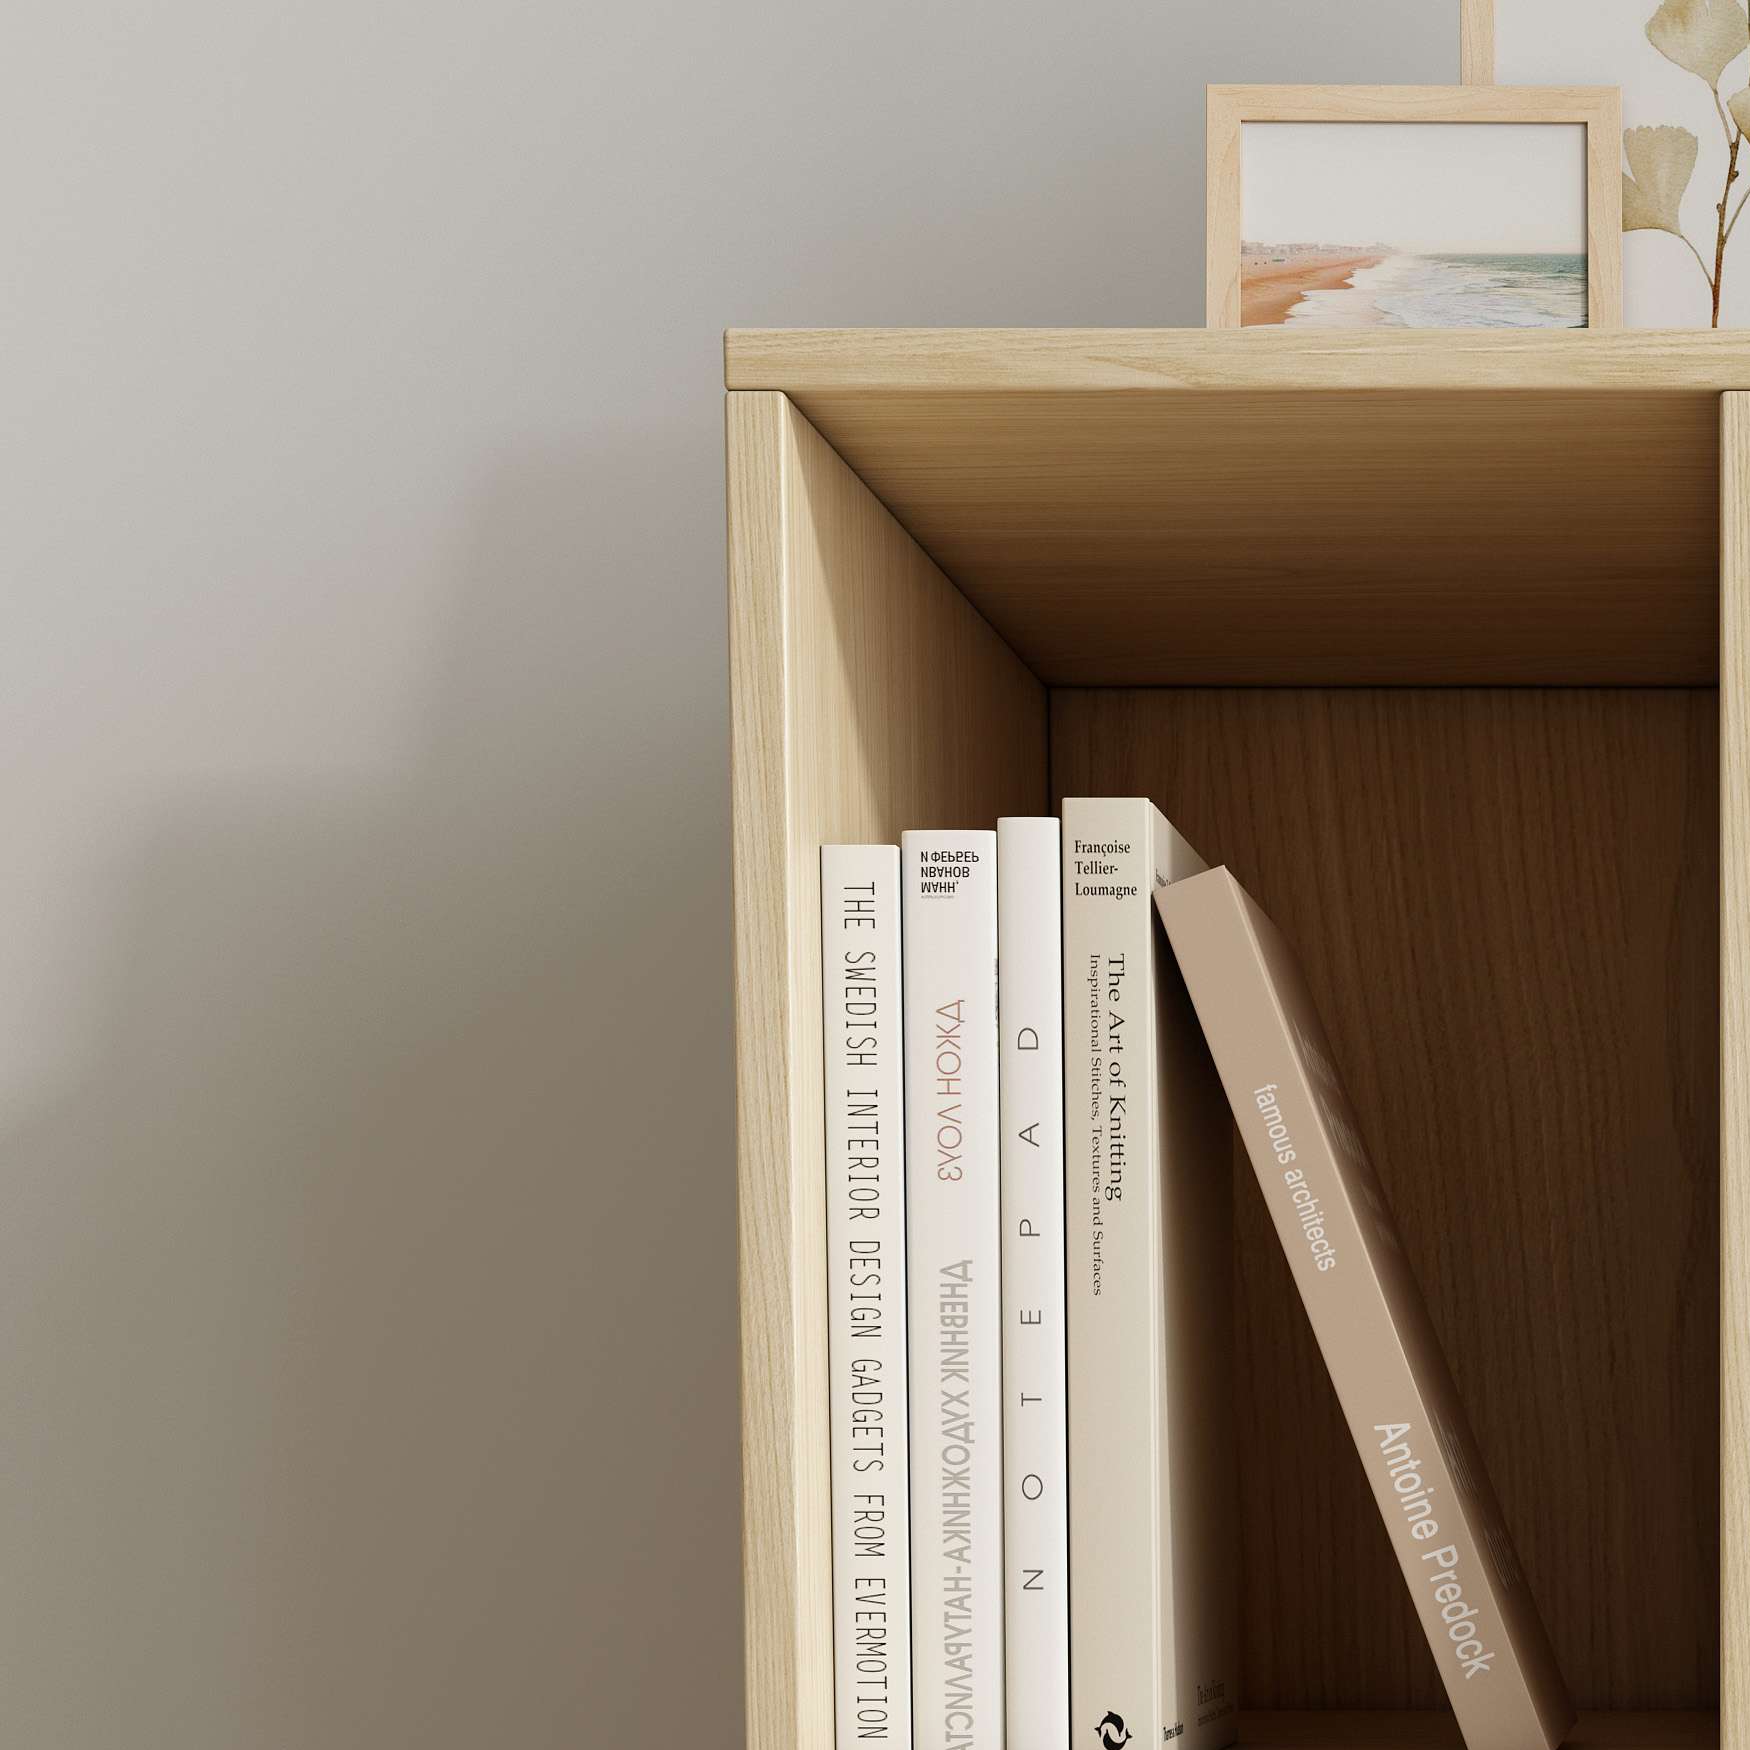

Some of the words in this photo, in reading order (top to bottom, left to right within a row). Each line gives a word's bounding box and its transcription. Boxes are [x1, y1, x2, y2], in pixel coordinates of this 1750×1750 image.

[1075, 840, 1130, 857] Françoise
[1075, 861, 1118, 875] Tellier-
[843, 882, 875, 930] THE
[1075, 882, 1137, 899] Loumagne
[845, 951, 877, 1066] SWEDISH
[1087, 954, 1101, 1044] Inspirational
[1108, 953, 1125, 1002] The
[1109, 1011, 1126, 1054] Art
[1091, 1045, 1102, 1120] Stitches,
[1109, 1062, 1126, 1089] of
[847, 1089, 881, 1220] INTERIOR
[1092, 1125, 1102, 1193] Textures
[1105, 1095, 1127, 1202] Knitting
[1253, 1084, 1297, 1166] famous
[1284, 1167, 1338, 1274] architects
[1093, 1198, 1102, 1220] and
[849, 1241, 882, 1338] DESIGN
[1093, 1226, 1104, 1296] Surfaces
[851, 1359, 883, 1472] GADGETS
[854, 1495, 885, 1558] FROM
[1373, 1421, 1441, 1543] Antoine
[1422, 1545, 1494, 1681] Predock
[856, 1579, 888, 1739] EVERMOTION
